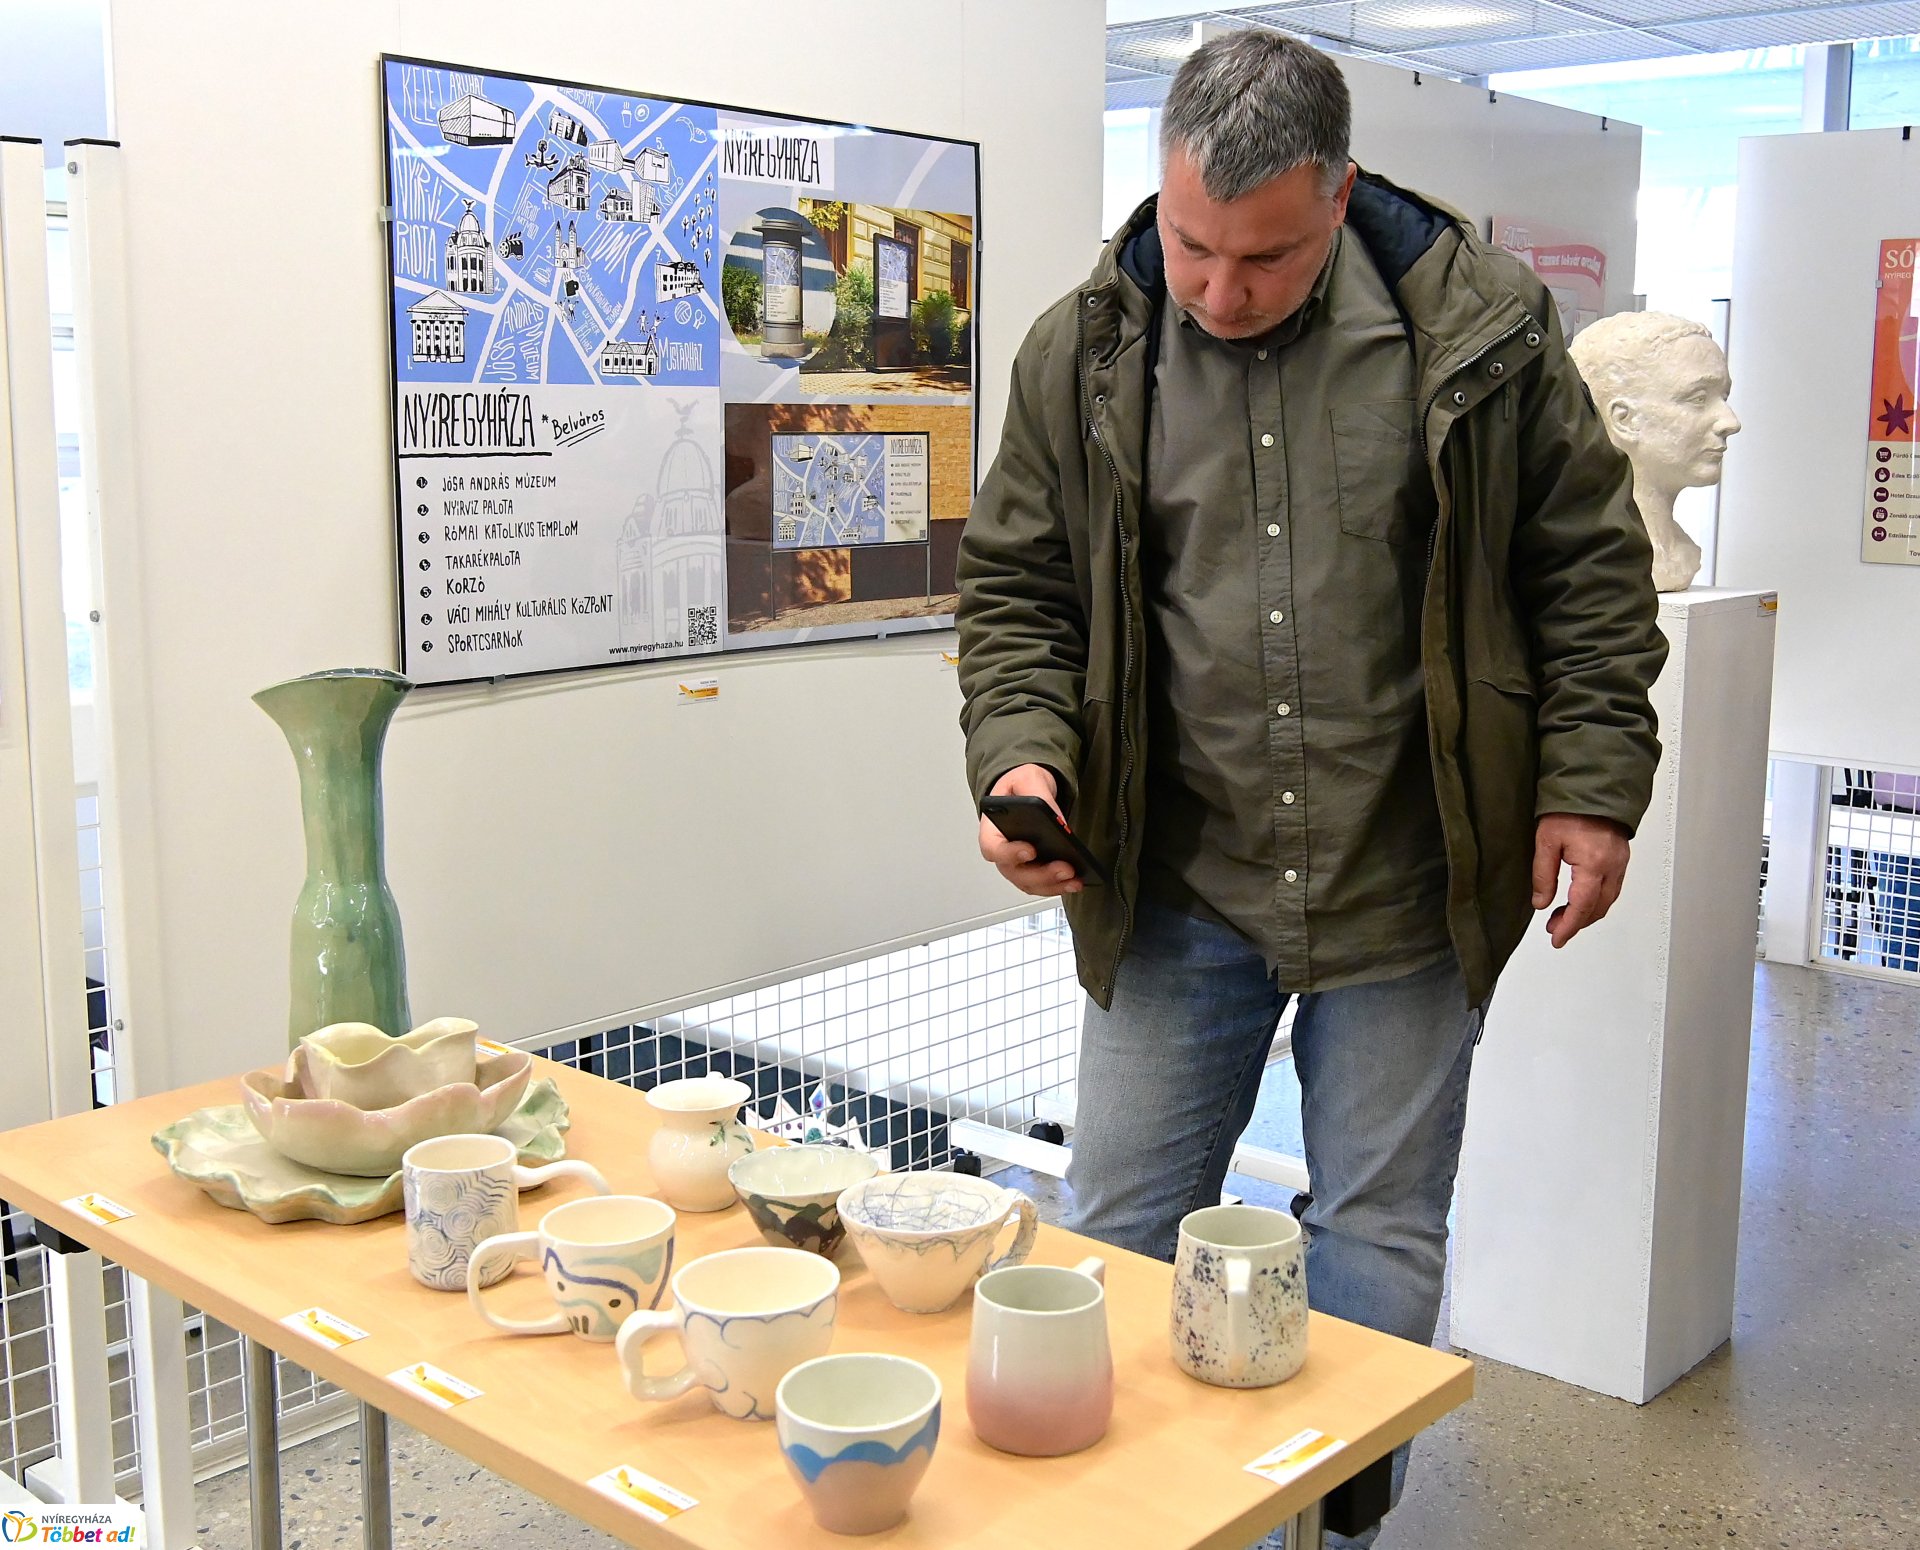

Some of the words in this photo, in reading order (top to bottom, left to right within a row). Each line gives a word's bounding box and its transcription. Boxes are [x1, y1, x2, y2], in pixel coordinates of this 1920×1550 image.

[401, 65, 443, 126] KELET
[396, 220, 438, 282] PALOTA
[1884, 244, 1915, 269] SÓ
[1884, 272, 1912, 280] NYÍREG
[404, 386, 535, 449] NYÍREGYHÁZA
[551, 409, 605, 440] Belváros
[442, 475, 465, 492] JÓSA
[470, 472, 510, 491] ANDRÁS
[515, 472, 557, 489] MÚZEUM
[482, 499, 514, 515] PALOTA
[444, 524, 478, 541] RÓMAI
[484, 521, 535, 540] KATOLIKUS
[536, 519, 579, 537] TEMPLOM
[445, 549, 521, 570] TAKARÉKPALOTA
[446, 576, 486, 595] KORZÓ
[447, 604, 470, 624] VÁCI
[475, 599, 511, 622] MIHÁLY
[516, 596, 567, 618] KULTURÁLIS
[571, 594, 614, 615] KÖZPONT
[448, 630, 524, 653] SPORTCSARNOK
[608, 640, 684, 655] www.nyiregyhaza.hu
